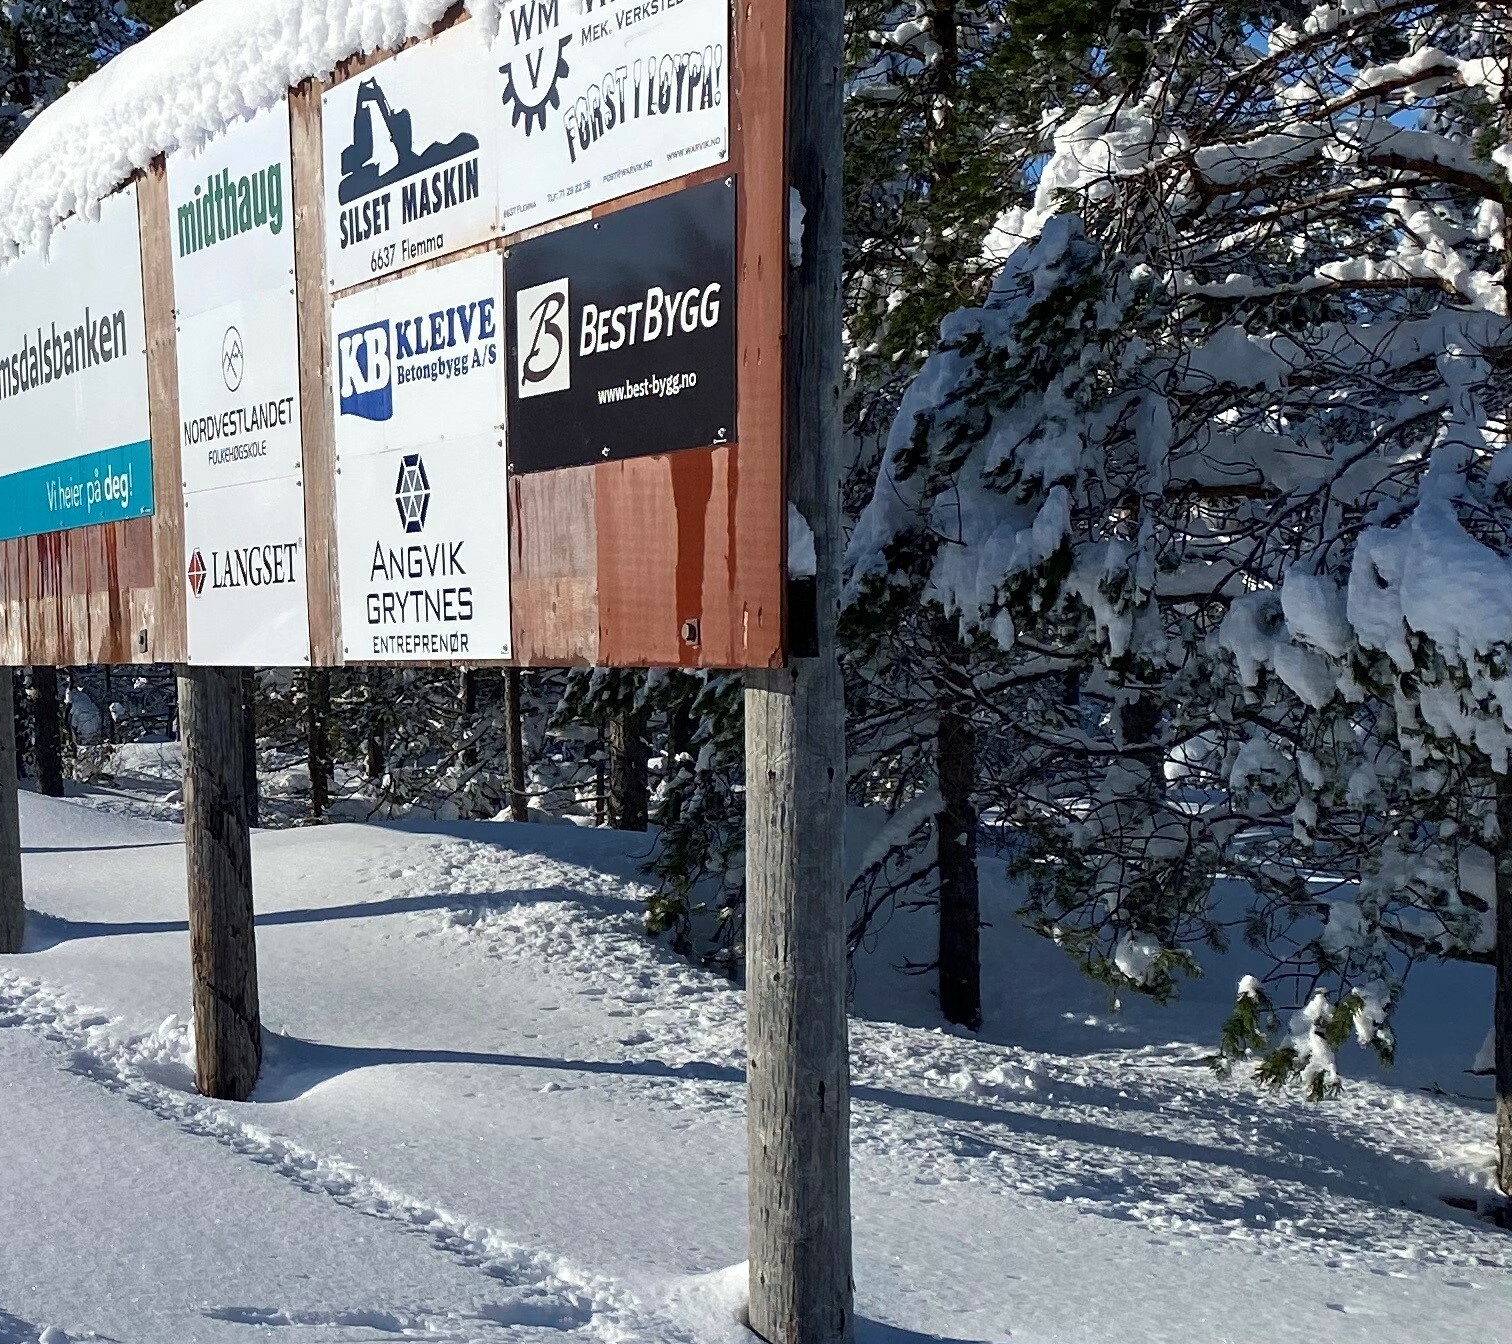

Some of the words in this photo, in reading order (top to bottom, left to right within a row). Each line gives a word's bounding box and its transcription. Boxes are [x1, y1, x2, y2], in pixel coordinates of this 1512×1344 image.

[581, 20, 612, 47] MEK.
[634, 58, 642, 119] I
[666, 136, 721, 161] WWW.WARVIK.NO
[177, 162, 283, 258] midthaug
[339, 192, 391, 249] SILSET
[402, 157, 480, 225] MASKIN
[370, 242, 396, 273] 6637
[401, 233, 444, 262] Flemma
[395, 297, 496, 360] KLEIVE
[339, 326, 391, 399] KB
[397, 353, 469, 385] Betongbygg
[471, 343, 497, 369] A/S
[597, 371, 697, 405] www.best-bygg.no
[183, 396, 294, 447] NORDVESTLANDET
[208, 439, 267, 467] FOLKEHØGSKOLE
[46, 480, 57, 512] Vi
[58, 476, 84, 510] heier
[86, 467, 102, 514] på
[103, 462, 133, 509] deg!
[211, 542, 298, 589] LANGSET
[370, 540, 467, 582] ANGVIK
[366, 586, 473, 624] GRYTNES
[373, 630, 470, 655] ENTREPRENØR
